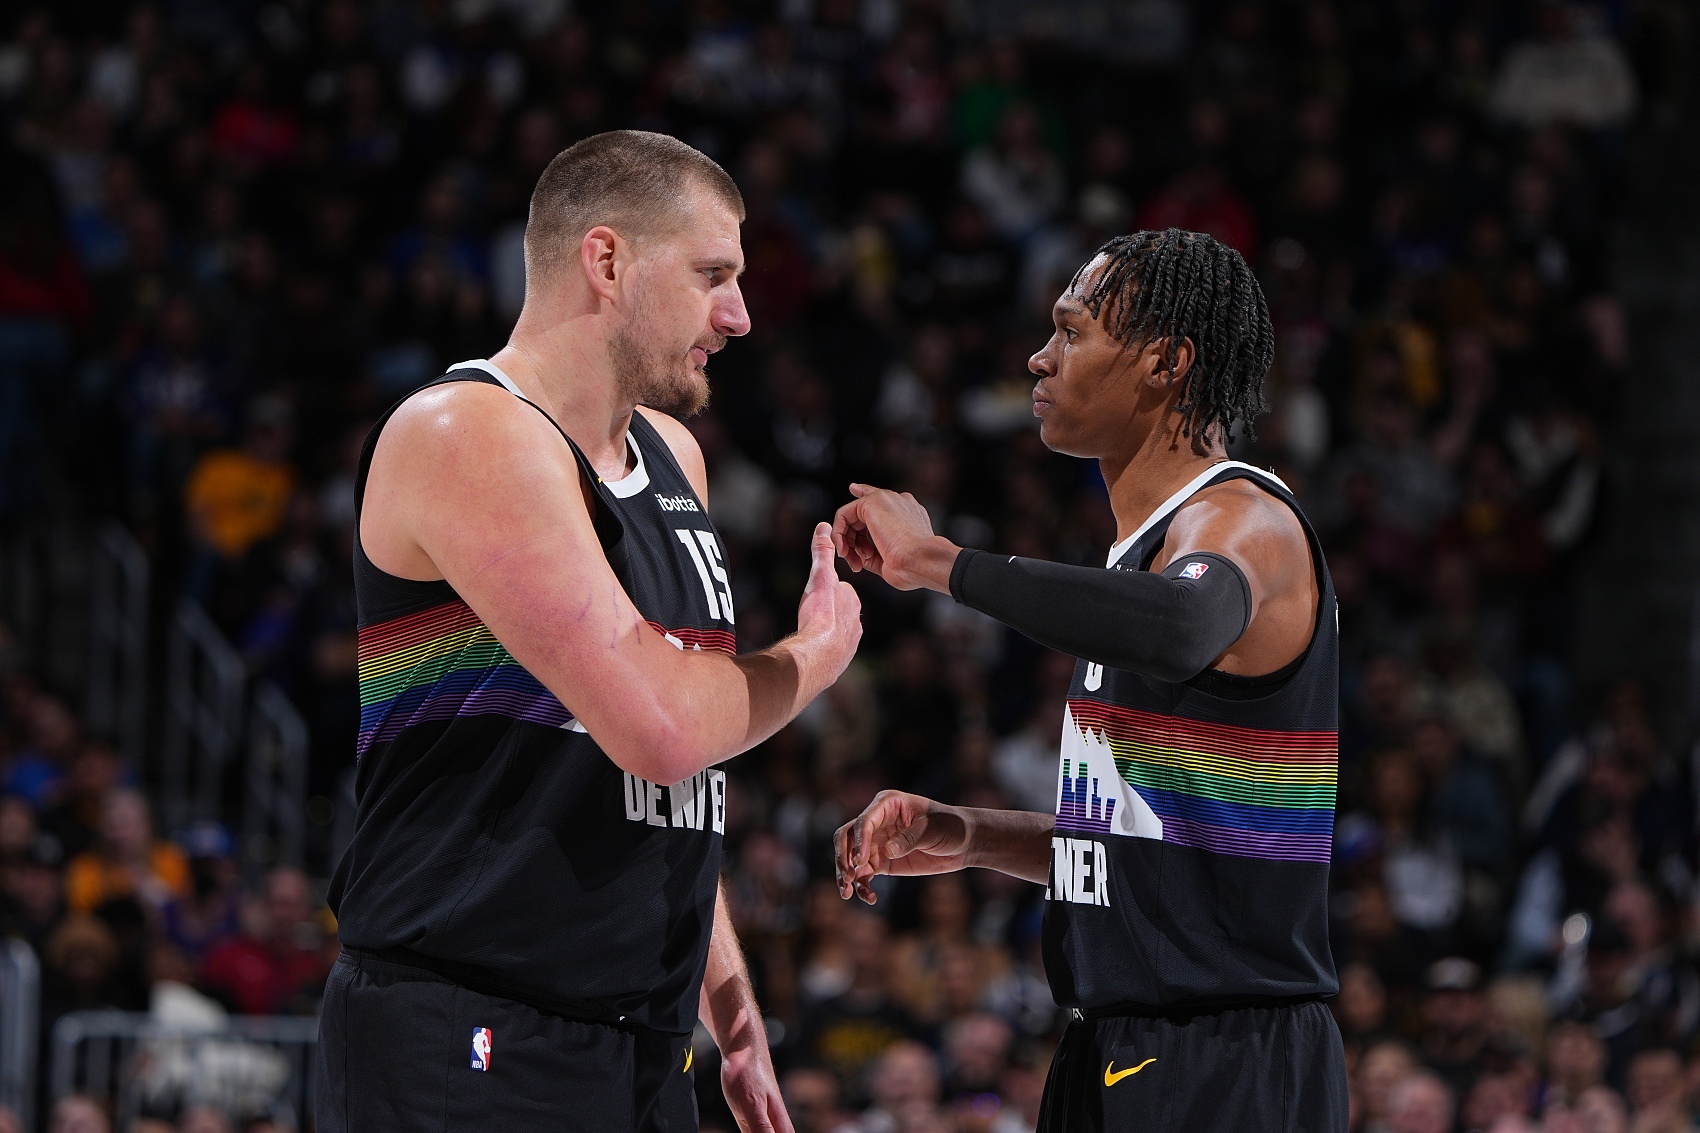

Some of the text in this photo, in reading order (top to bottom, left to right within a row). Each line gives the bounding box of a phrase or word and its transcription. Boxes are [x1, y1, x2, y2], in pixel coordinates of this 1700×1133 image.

[655, 493, 699, 512] ibotta
[674, 529, 735, 625] 15
[623, 766, 726, 836] DENVE
[471, 1060, 483, 1069] NBA
